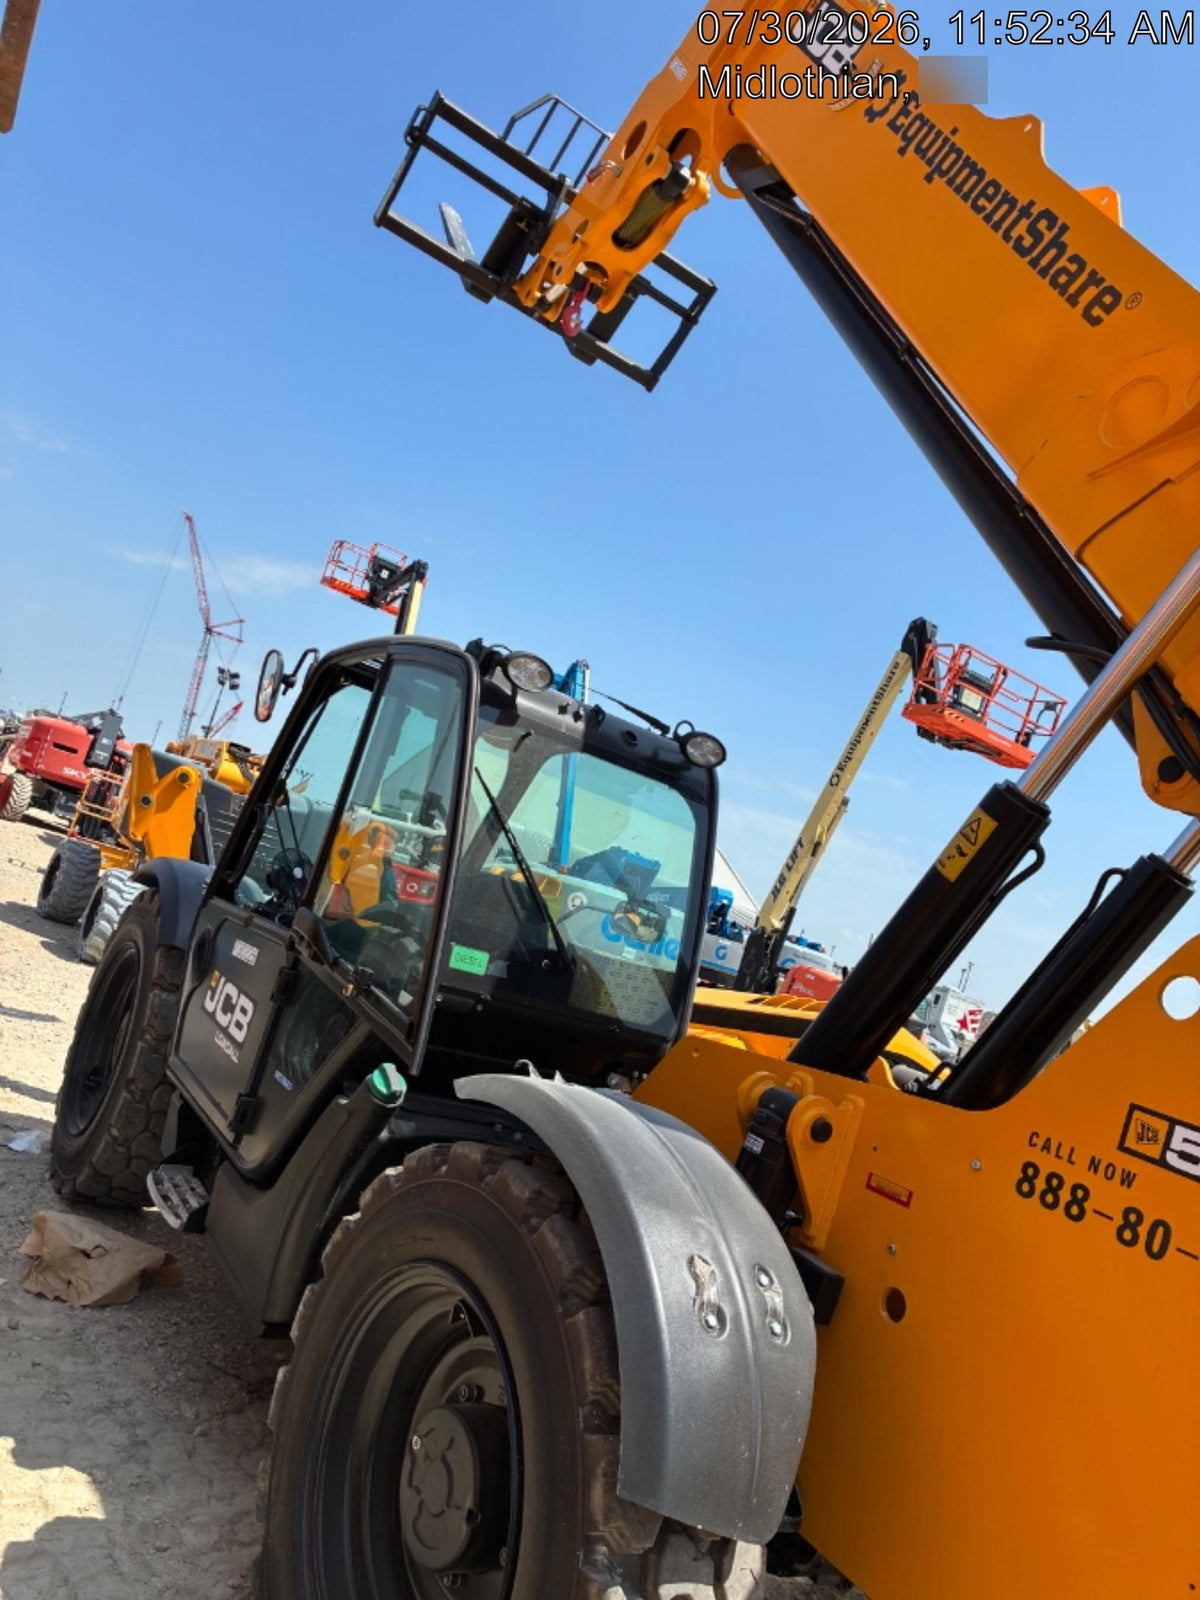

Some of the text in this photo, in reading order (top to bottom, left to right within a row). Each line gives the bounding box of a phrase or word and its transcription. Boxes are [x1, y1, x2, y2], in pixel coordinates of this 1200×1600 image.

[785, 836, 804, 872] LIFT
[204, 976, 254, 1043] JCB
[1136, 1120, 1160, 1144] JCB
[1027, 1131, 1137, 1190] CALL NOW
